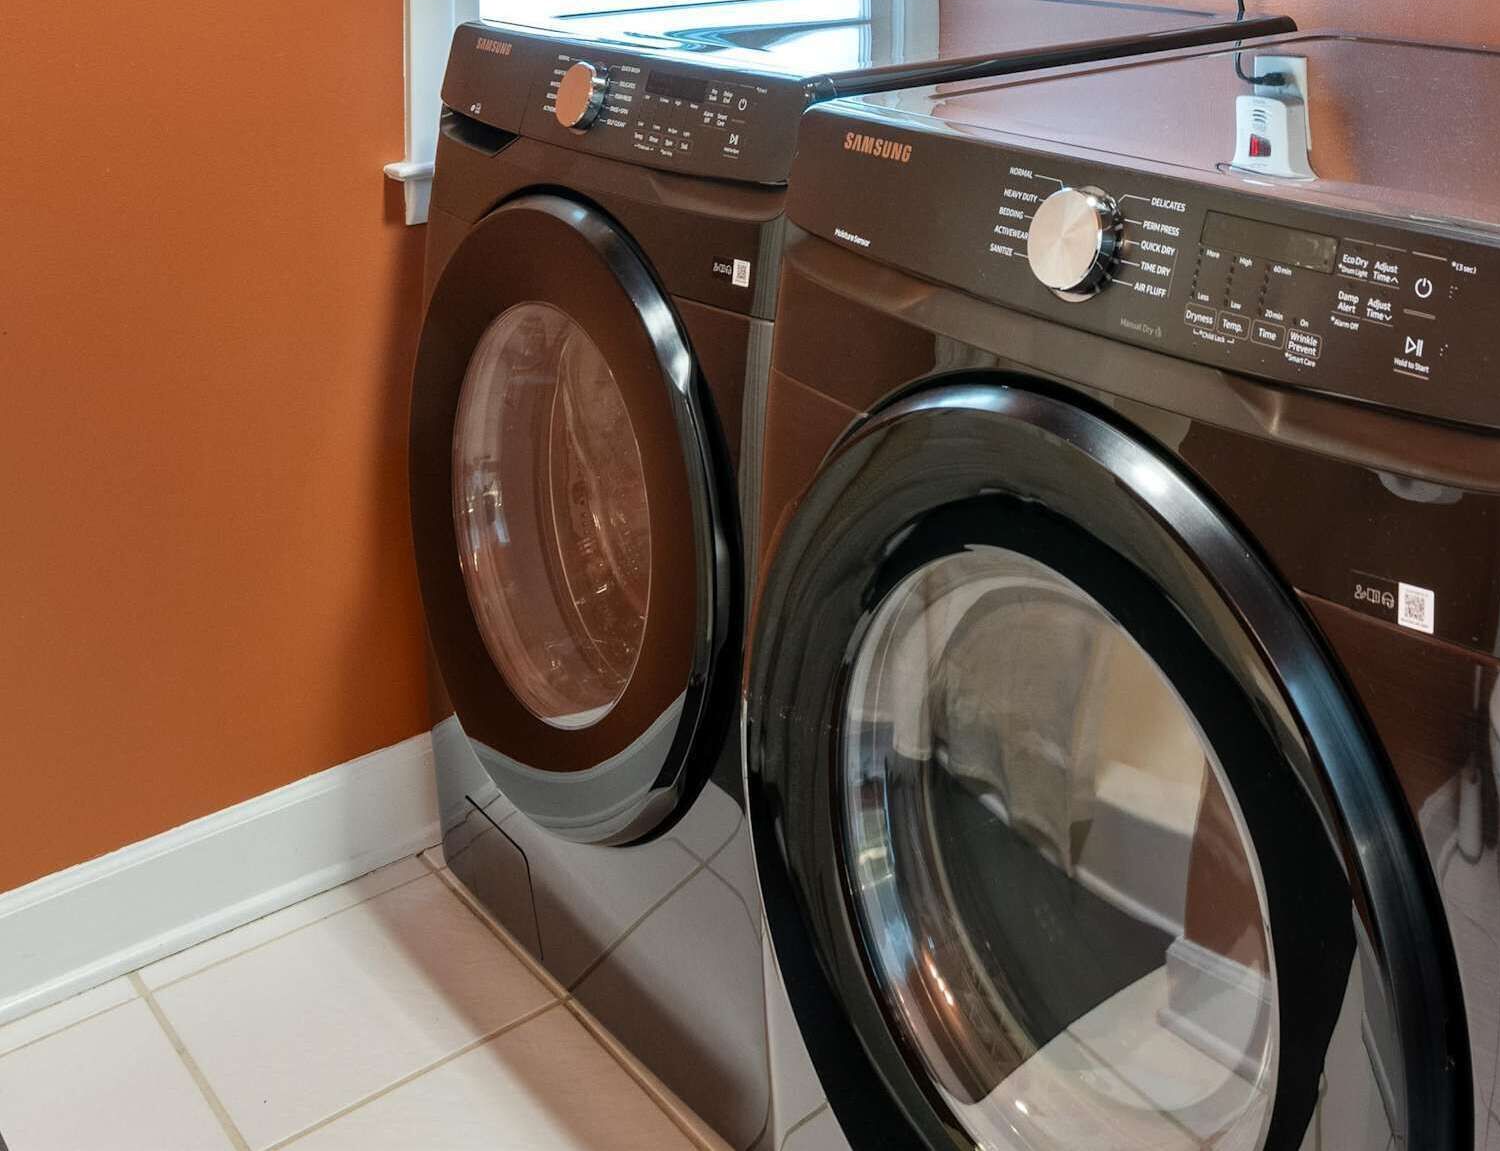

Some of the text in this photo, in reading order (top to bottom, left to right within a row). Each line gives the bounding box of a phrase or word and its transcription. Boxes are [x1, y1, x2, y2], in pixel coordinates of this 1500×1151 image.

[844, 132, 912, 163] SAMSUNG
[1009, 166, 1033, 179] NORMAL
[1004, 188, 1038, 202] HEAVY DUTY
[1152, 197, 1186, 212] DELICATES
[998, 206, 1024, 220] BEDDING
[994, 224, 1029, 240] ACTIVEWEAR
[1142, 220, 1181, 237] PERM PRESS
[1140, 240, 1176, 257] QUICK DRY
[1140, 260, 1172, 278] TIME DRY
[1239, 257, 1253, 268] High
[1342, 254, 1369, 269] Eco Dry
[1374, 262, 1399, 274] Adjust
[1373, 272, 1391, 284] Time
[1134, 282, 1168, 298] AIR FLUFF
[1338, 290, 1360, 305] Damp
[1338, 302, 1356, 314] Alert
[1367, 298, 1392, 312] Adjust
[1185, 310, 1214, 325] Dryness
[1366, 309, 1384, 320] Time
[1222, 319, 1243, 334] Temp.
[1258, 328, 1277, 341] Time
[1290, 332, 1318, 347] Wrinkle
[1288, 340, 1317, 356] Prevent
